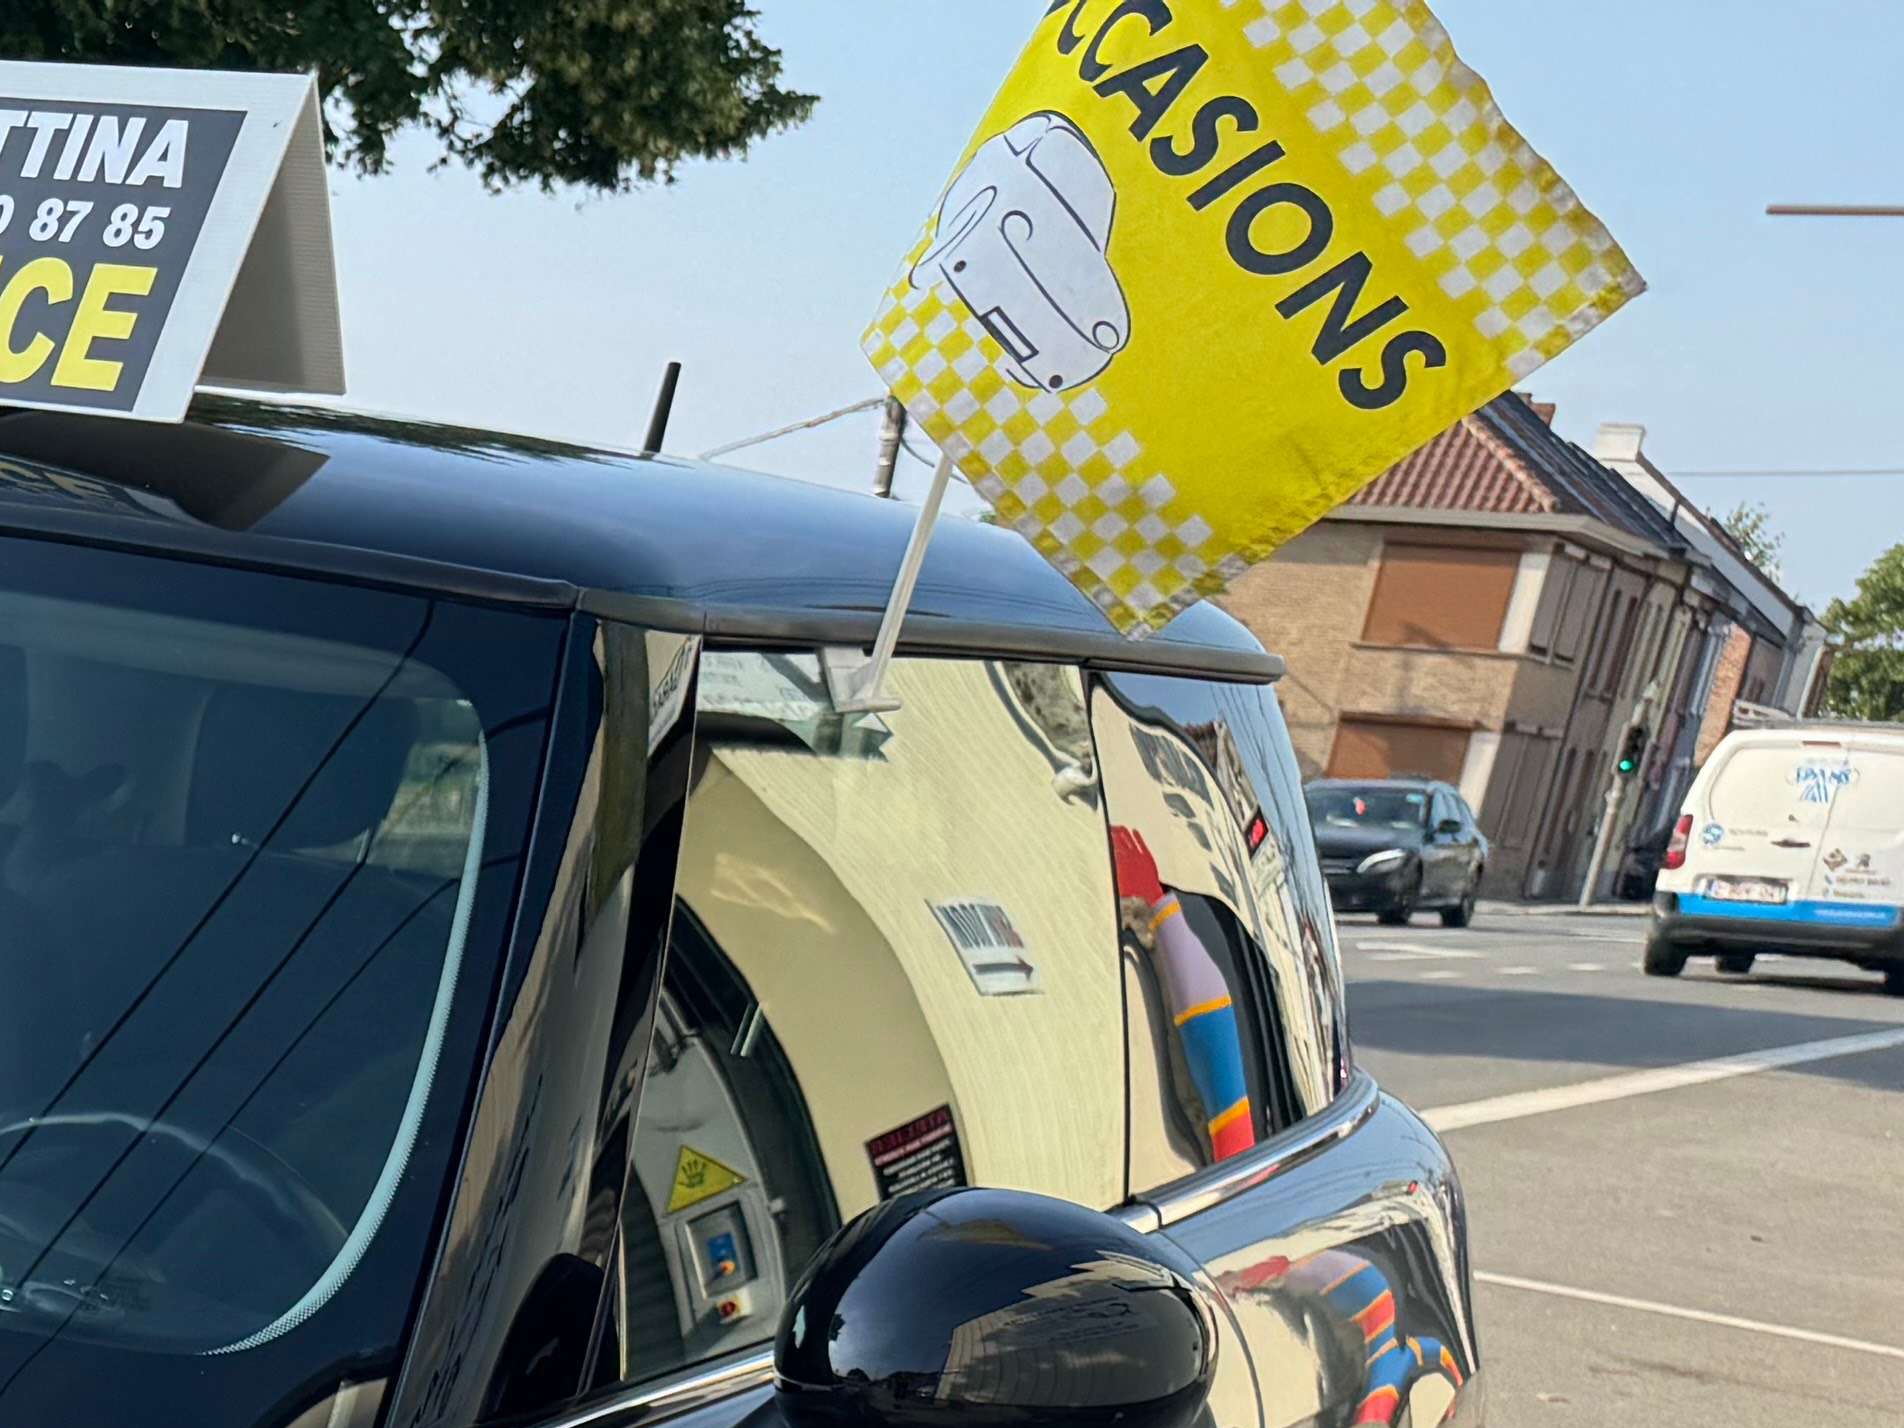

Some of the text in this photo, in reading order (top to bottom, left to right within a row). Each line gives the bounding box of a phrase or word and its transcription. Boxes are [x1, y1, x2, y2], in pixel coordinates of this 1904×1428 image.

[29, 199, 93, 244] 87
[102, 205, 171, 250] 85
[1044, 0, 1445, 409] CASIONS
